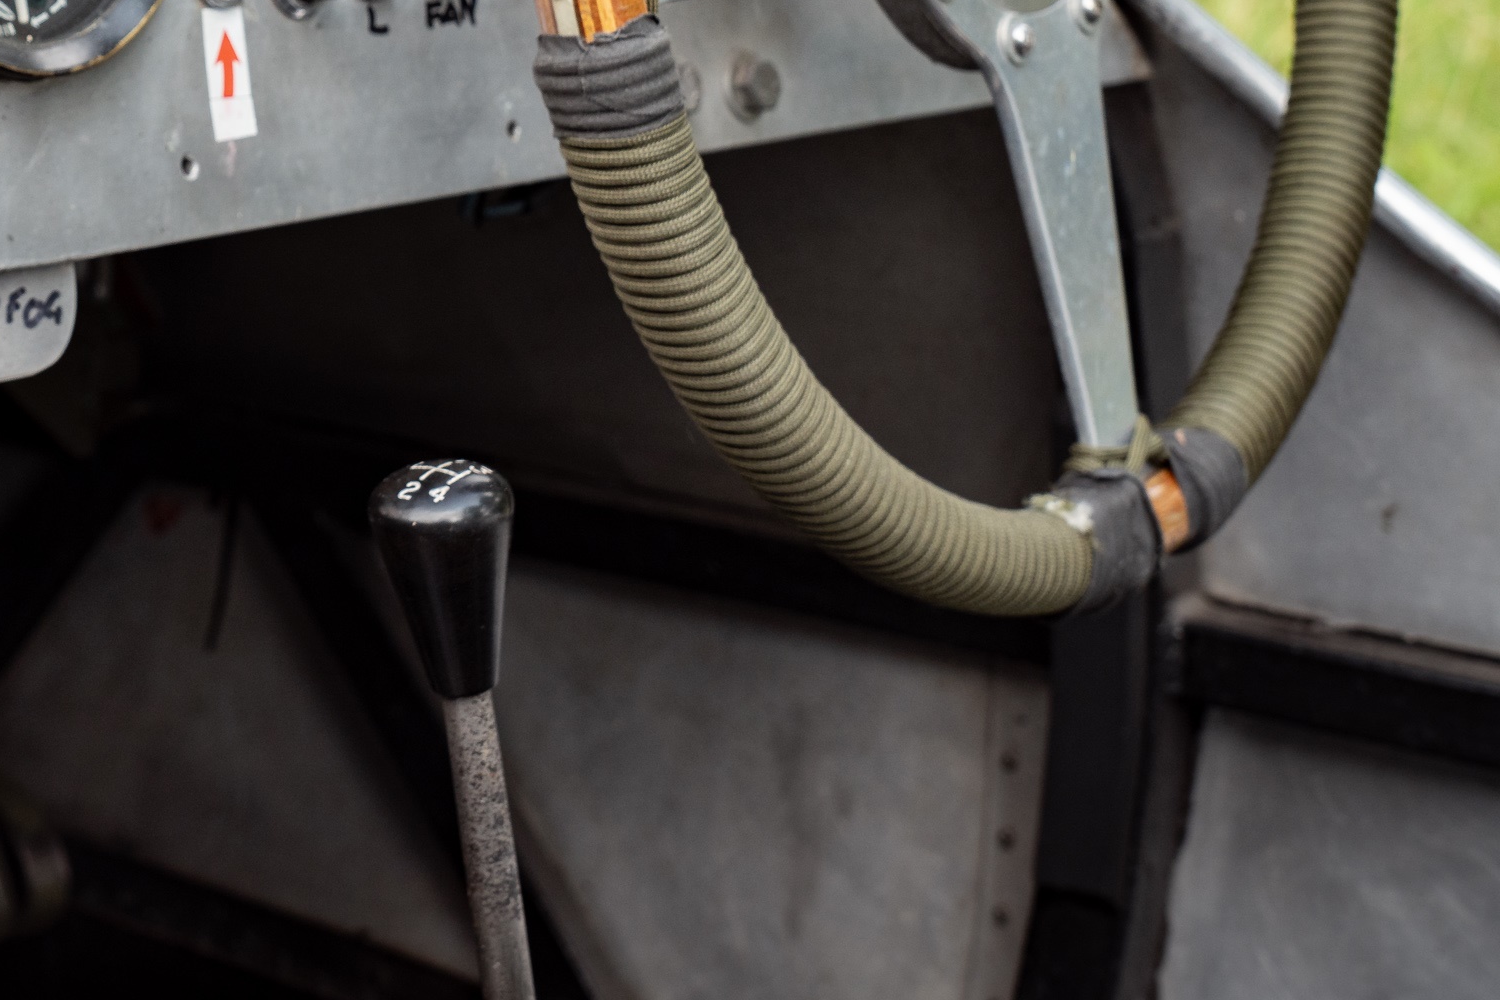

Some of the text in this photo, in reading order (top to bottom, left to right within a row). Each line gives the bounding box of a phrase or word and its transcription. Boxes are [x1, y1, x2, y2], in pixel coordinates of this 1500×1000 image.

[367, 4, 390, 35] L
[397, 480, 421, 501] 2
[428, 485, 451, 503] 4
